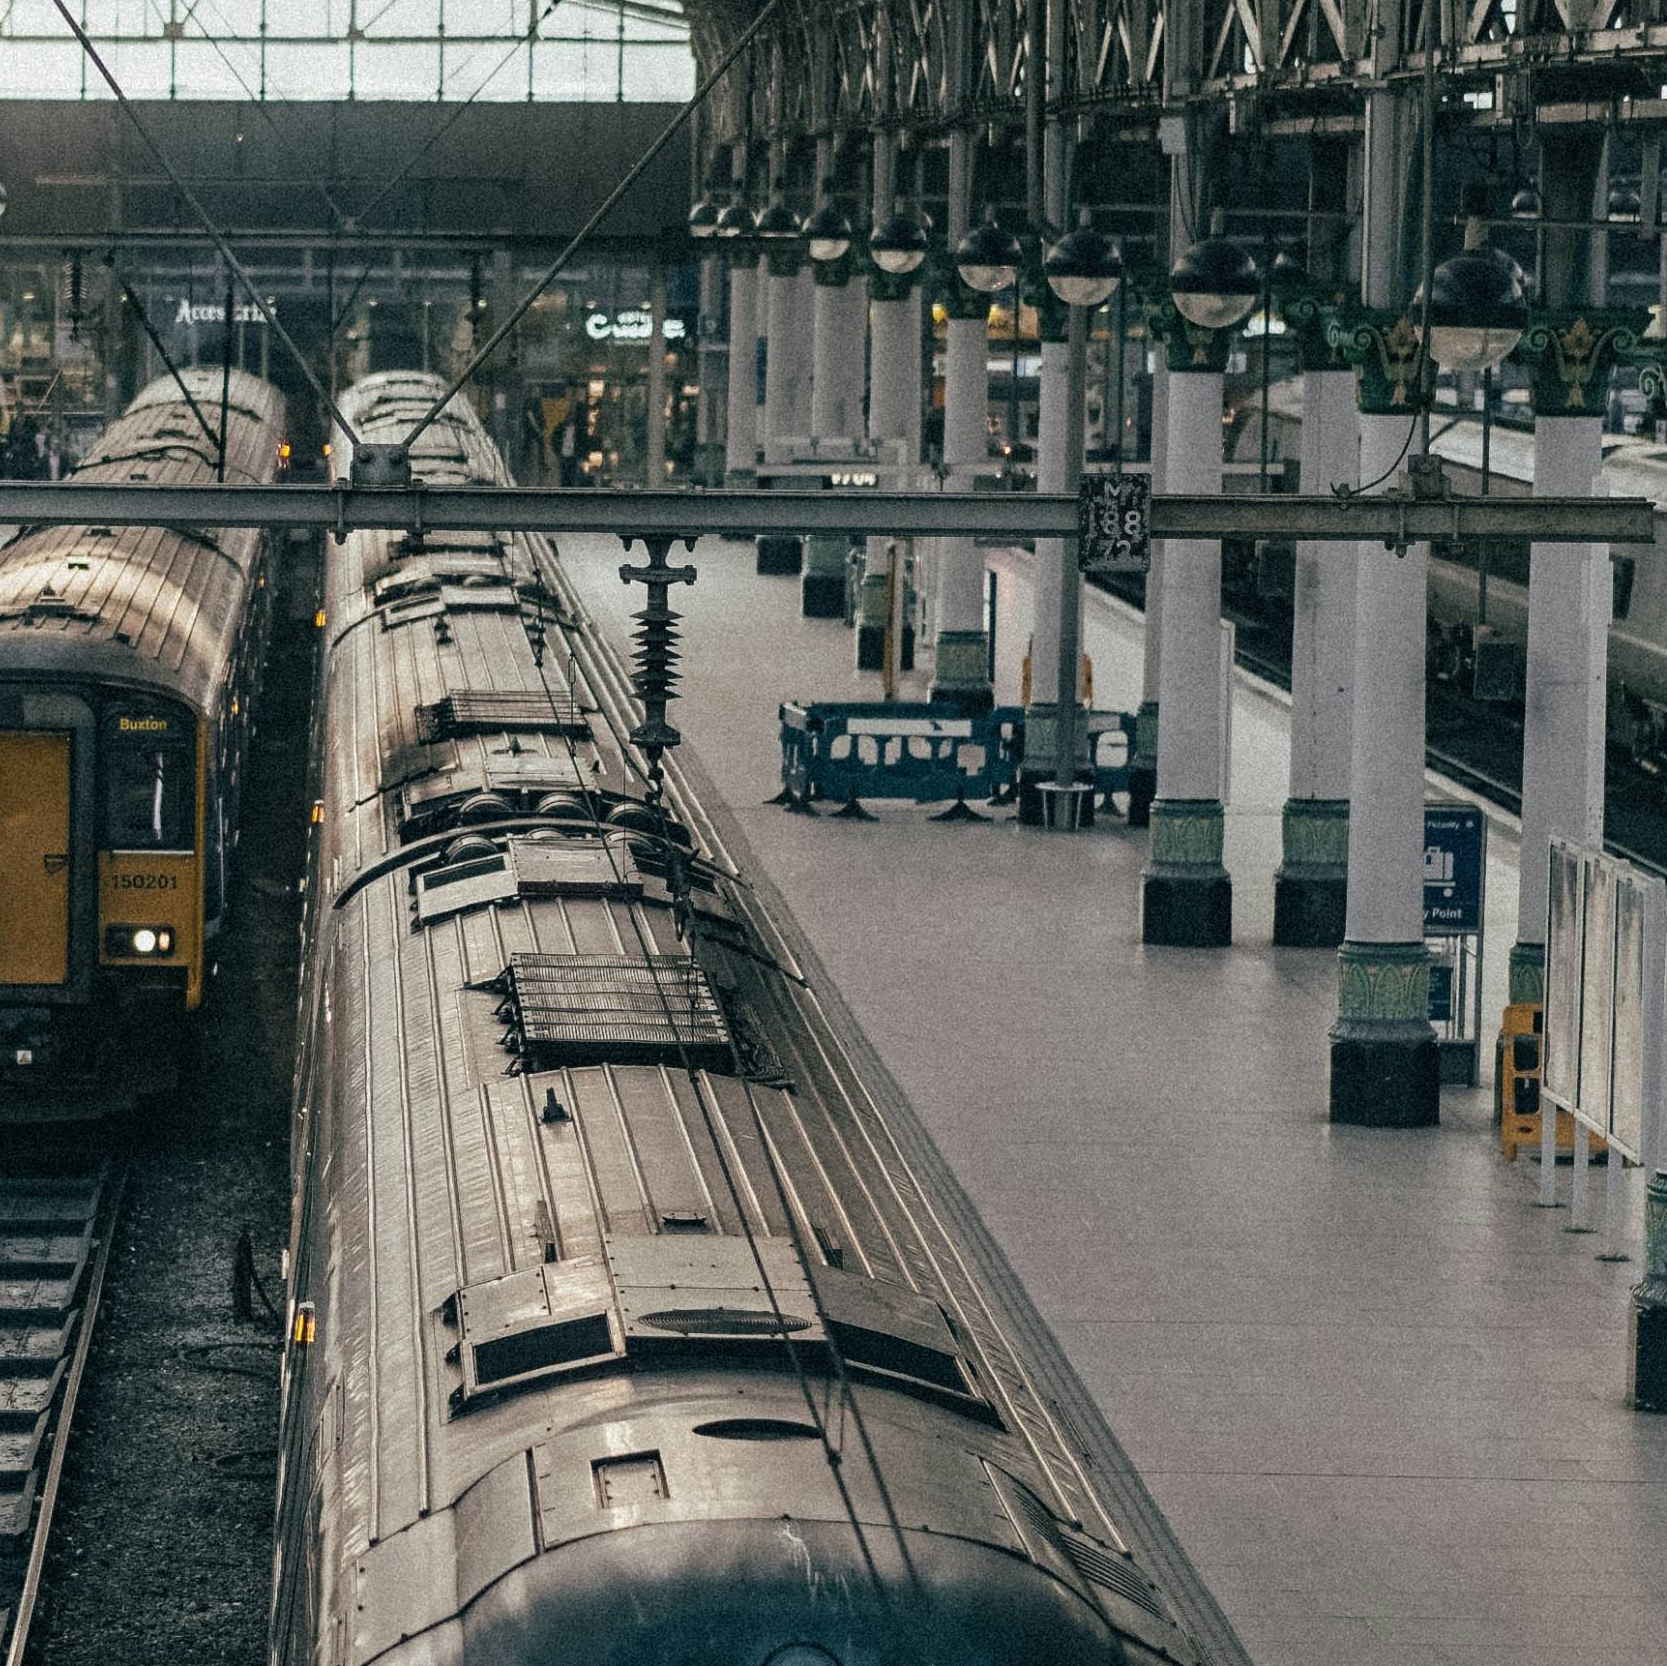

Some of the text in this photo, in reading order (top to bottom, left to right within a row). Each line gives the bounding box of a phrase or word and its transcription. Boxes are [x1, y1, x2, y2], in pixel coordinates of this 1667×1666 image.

[119, 717, 167, 731] Buxton
[112, 874, 177, 889] 150201
[1432, 907, 1463, 919] Point
